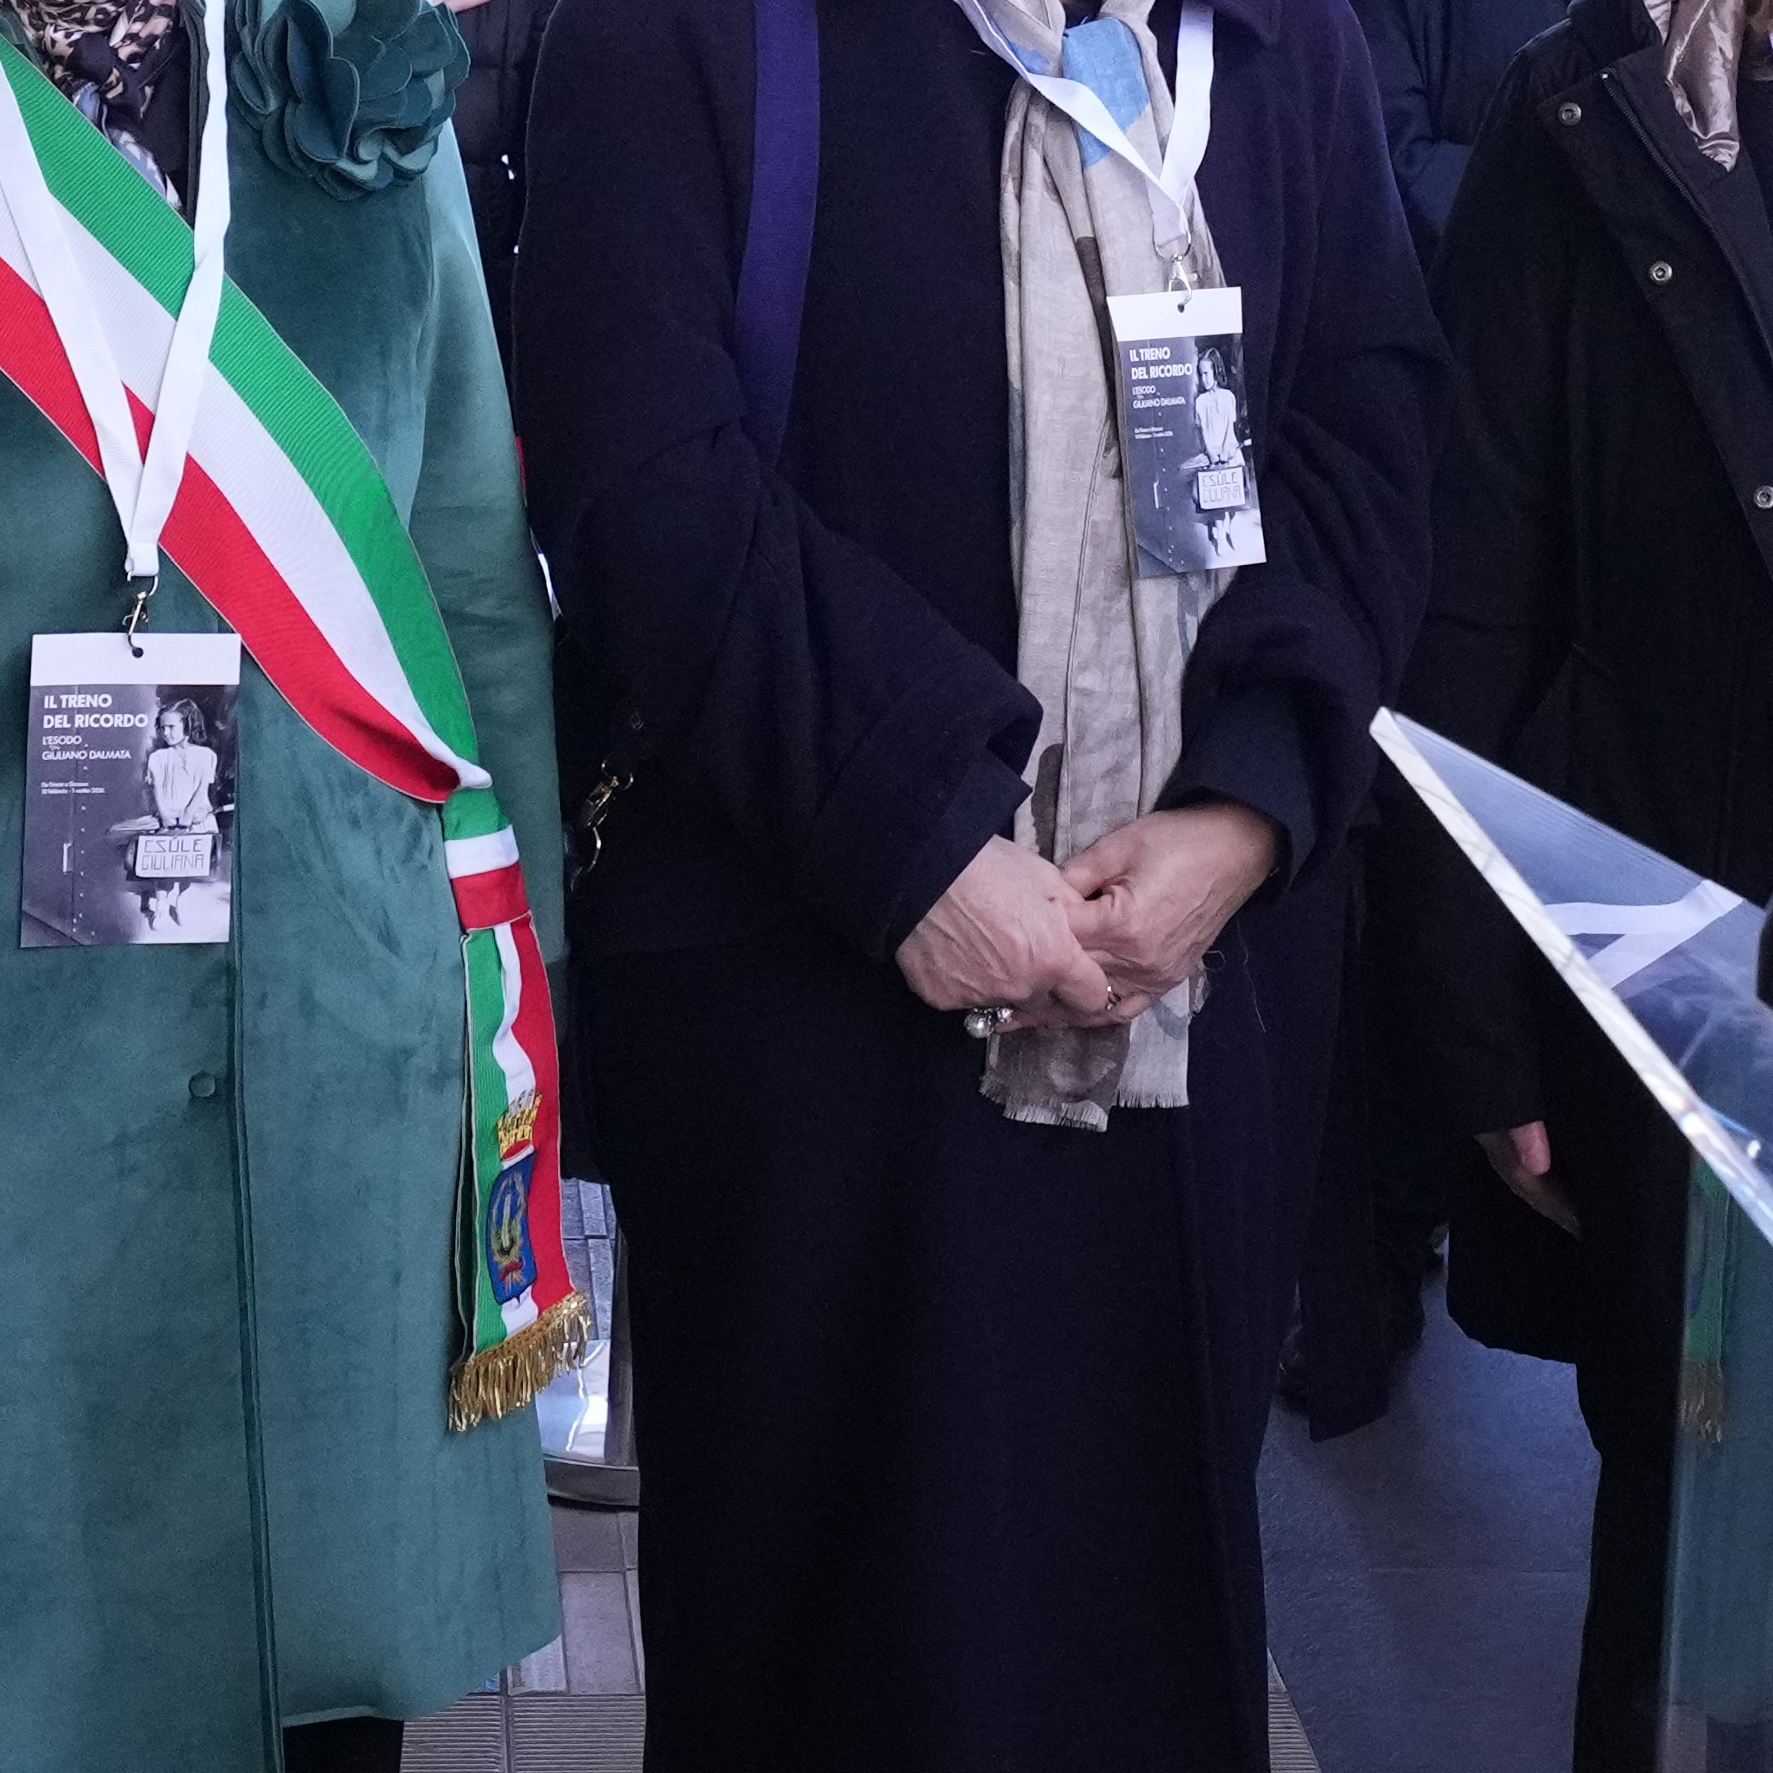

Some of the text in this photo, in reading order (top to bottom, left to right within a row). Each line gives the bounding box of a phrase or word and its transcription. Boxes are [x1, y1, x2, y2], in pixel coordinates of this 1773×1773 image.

[1139, 346, 1171, 361] TRENO
[1131, 362, 1193, 381] DEL RICORDO
[44, 693, 113, 710] IL TRENO
[43, 713, 149, 729] DEL RICORDO
[42, 735, 83, 746] L'ESODO
[42, 749, 132, 761] GIULIANO DALMATA
[144, 838, 203, 854] ESULE
[141, 853, 205, 871] GIULIANA
